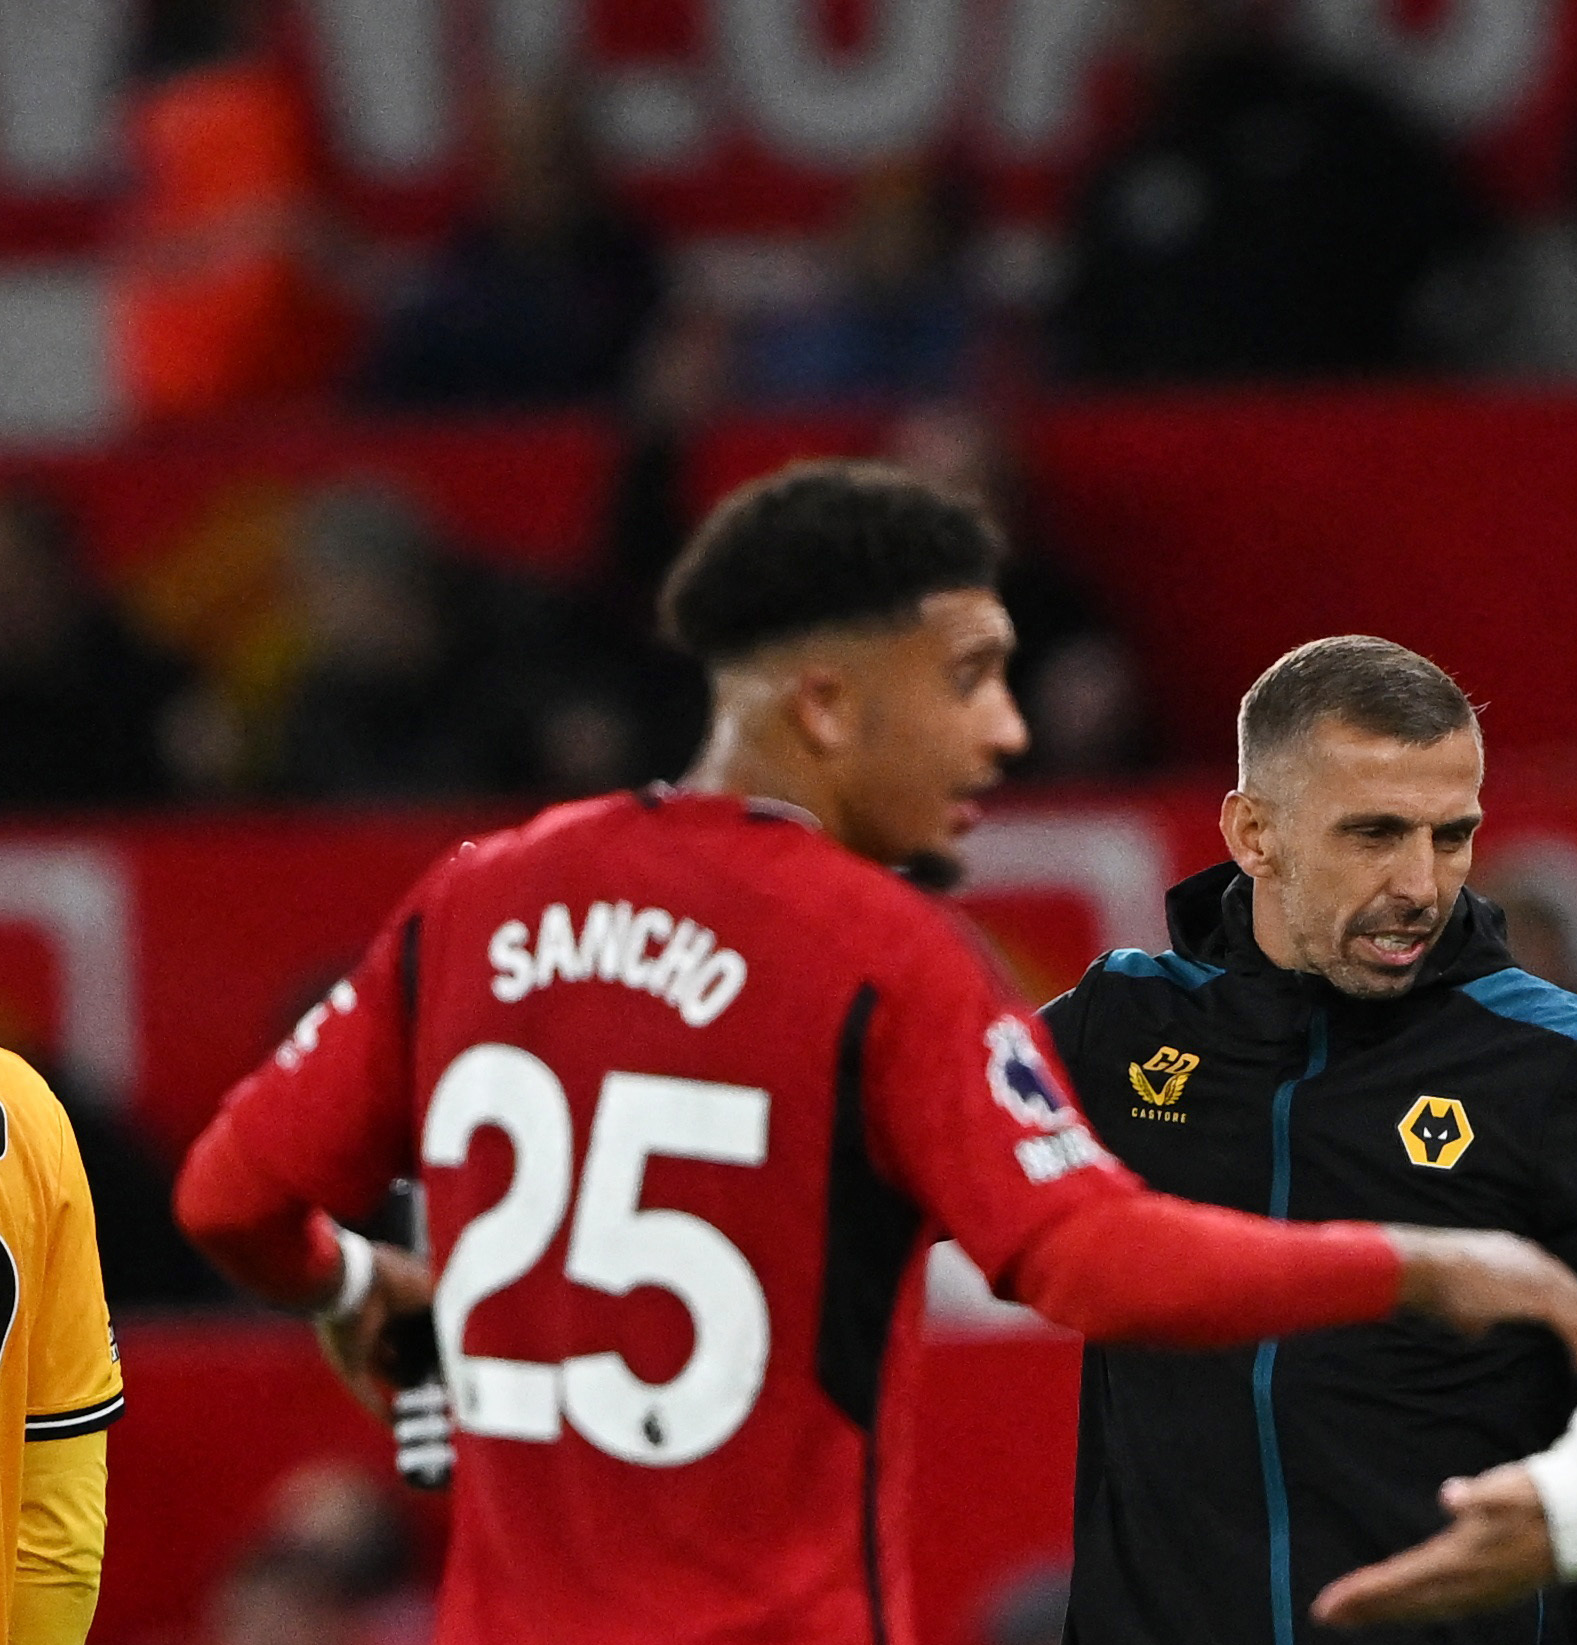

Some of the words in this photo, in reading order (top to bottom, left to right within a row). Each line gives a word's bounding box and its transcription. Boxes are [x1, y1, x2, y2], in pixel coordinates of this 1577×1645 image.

[486, 900, 749, 1028] SANCHO
[1131, 1107, 1187, 1123] CASTORE
[421, 1042, 772, 1467] 25
